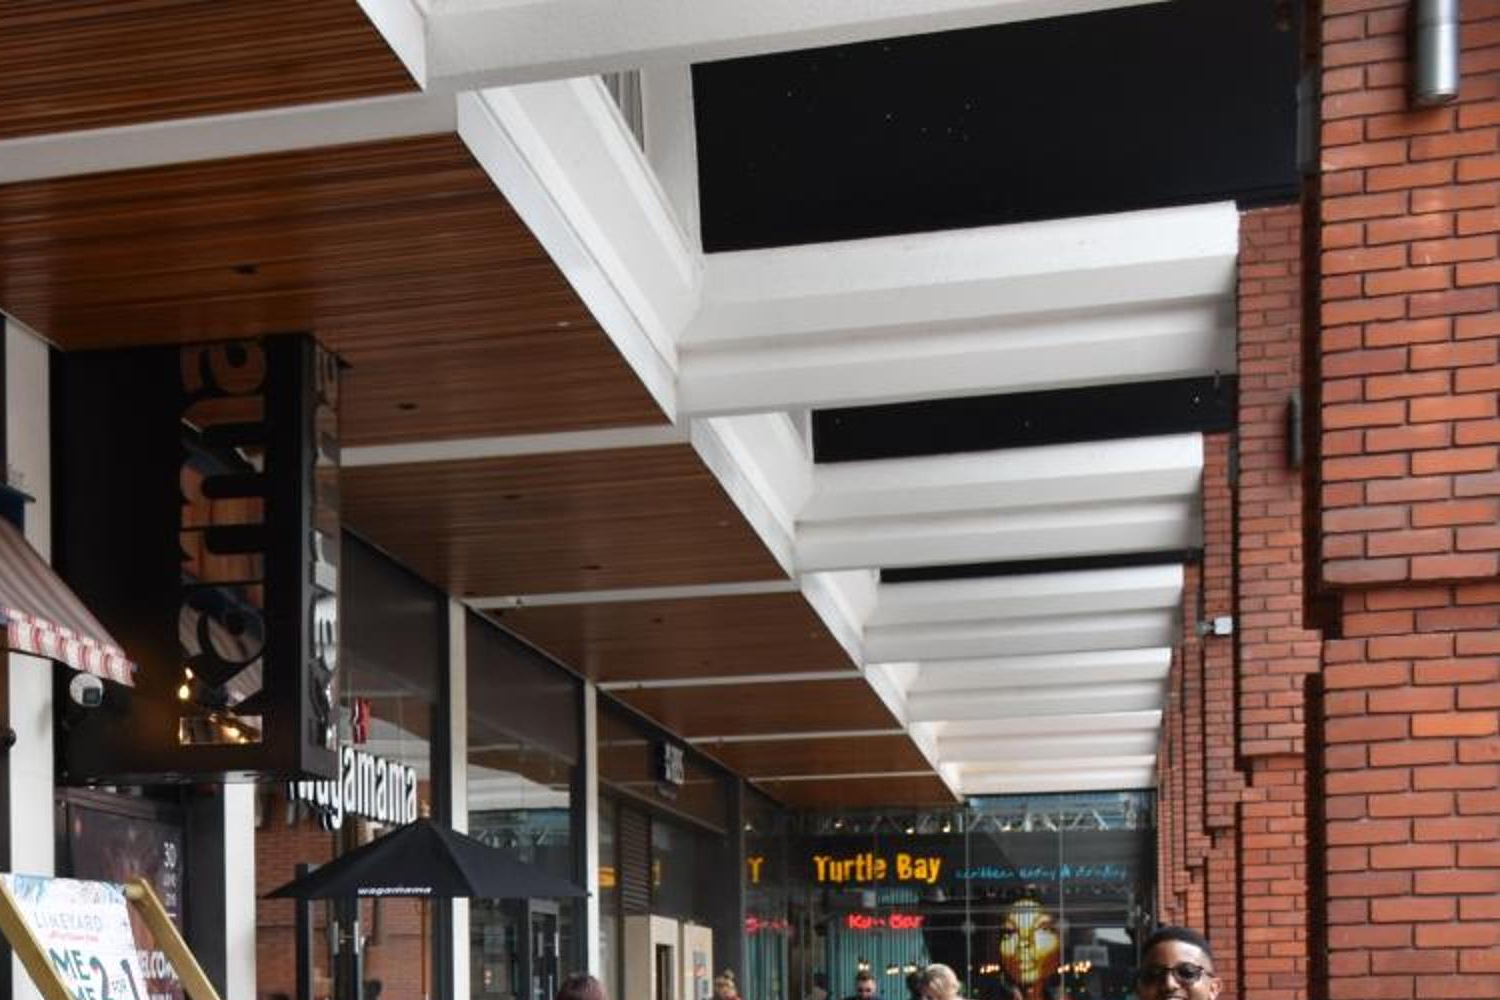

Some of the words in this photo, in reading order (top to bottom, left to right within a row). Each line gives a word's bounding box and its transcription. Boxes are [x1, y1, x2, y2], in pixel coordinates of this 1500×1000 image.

[297, 744, 418, 831] gamama
[812, 852, 888, 882] Turtle
[896, 852, 941, 884] Bay
